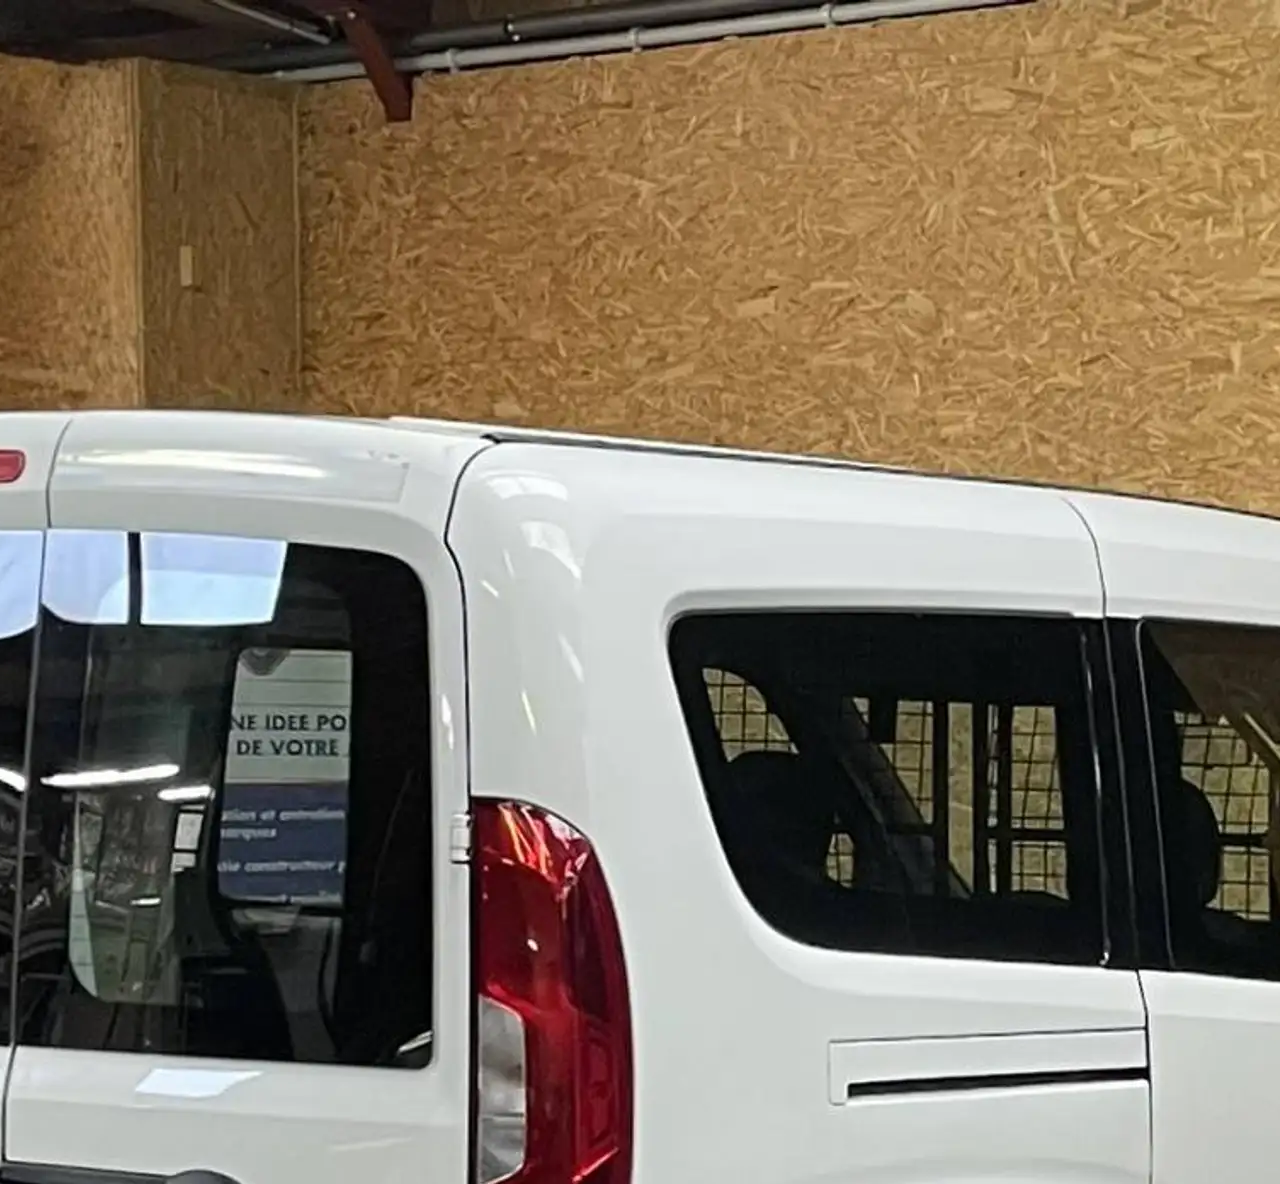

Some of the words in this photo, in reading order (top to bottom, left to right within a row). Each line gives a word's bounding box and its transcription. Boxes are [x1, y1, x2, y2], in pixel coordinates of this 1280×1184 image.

[265, 714, 309, 731] IDEE
[317, 714, 347, 732] PO
[236, 739, 263, 756] DE
[269, 739, 339, 757] VOTRE
